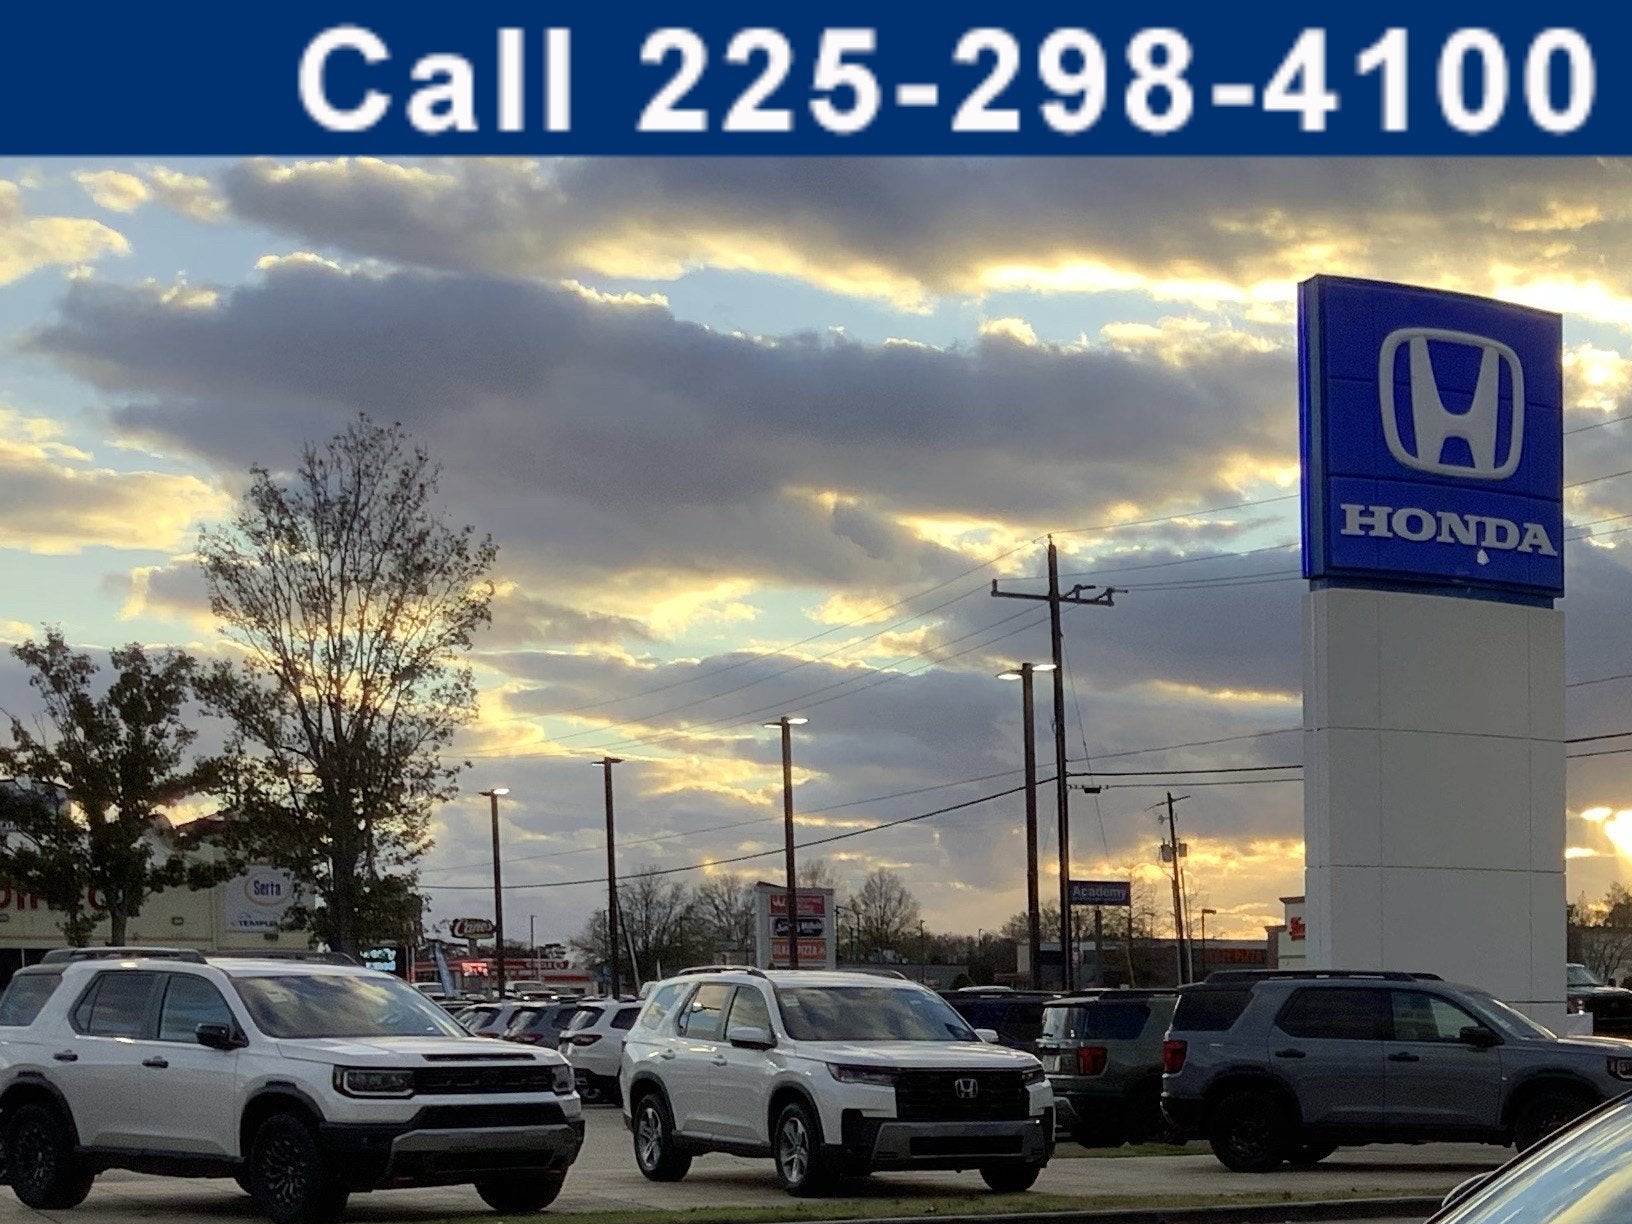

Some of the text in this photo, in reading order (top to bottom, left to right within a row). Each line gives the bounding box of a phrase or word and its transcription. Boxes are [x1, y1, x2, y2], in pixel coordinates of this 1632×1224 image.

[1340, 503, 1558, 557] HONDA
[253, 880, 281, 896] Serta
[1072, 885, 1126, 901] Academy
